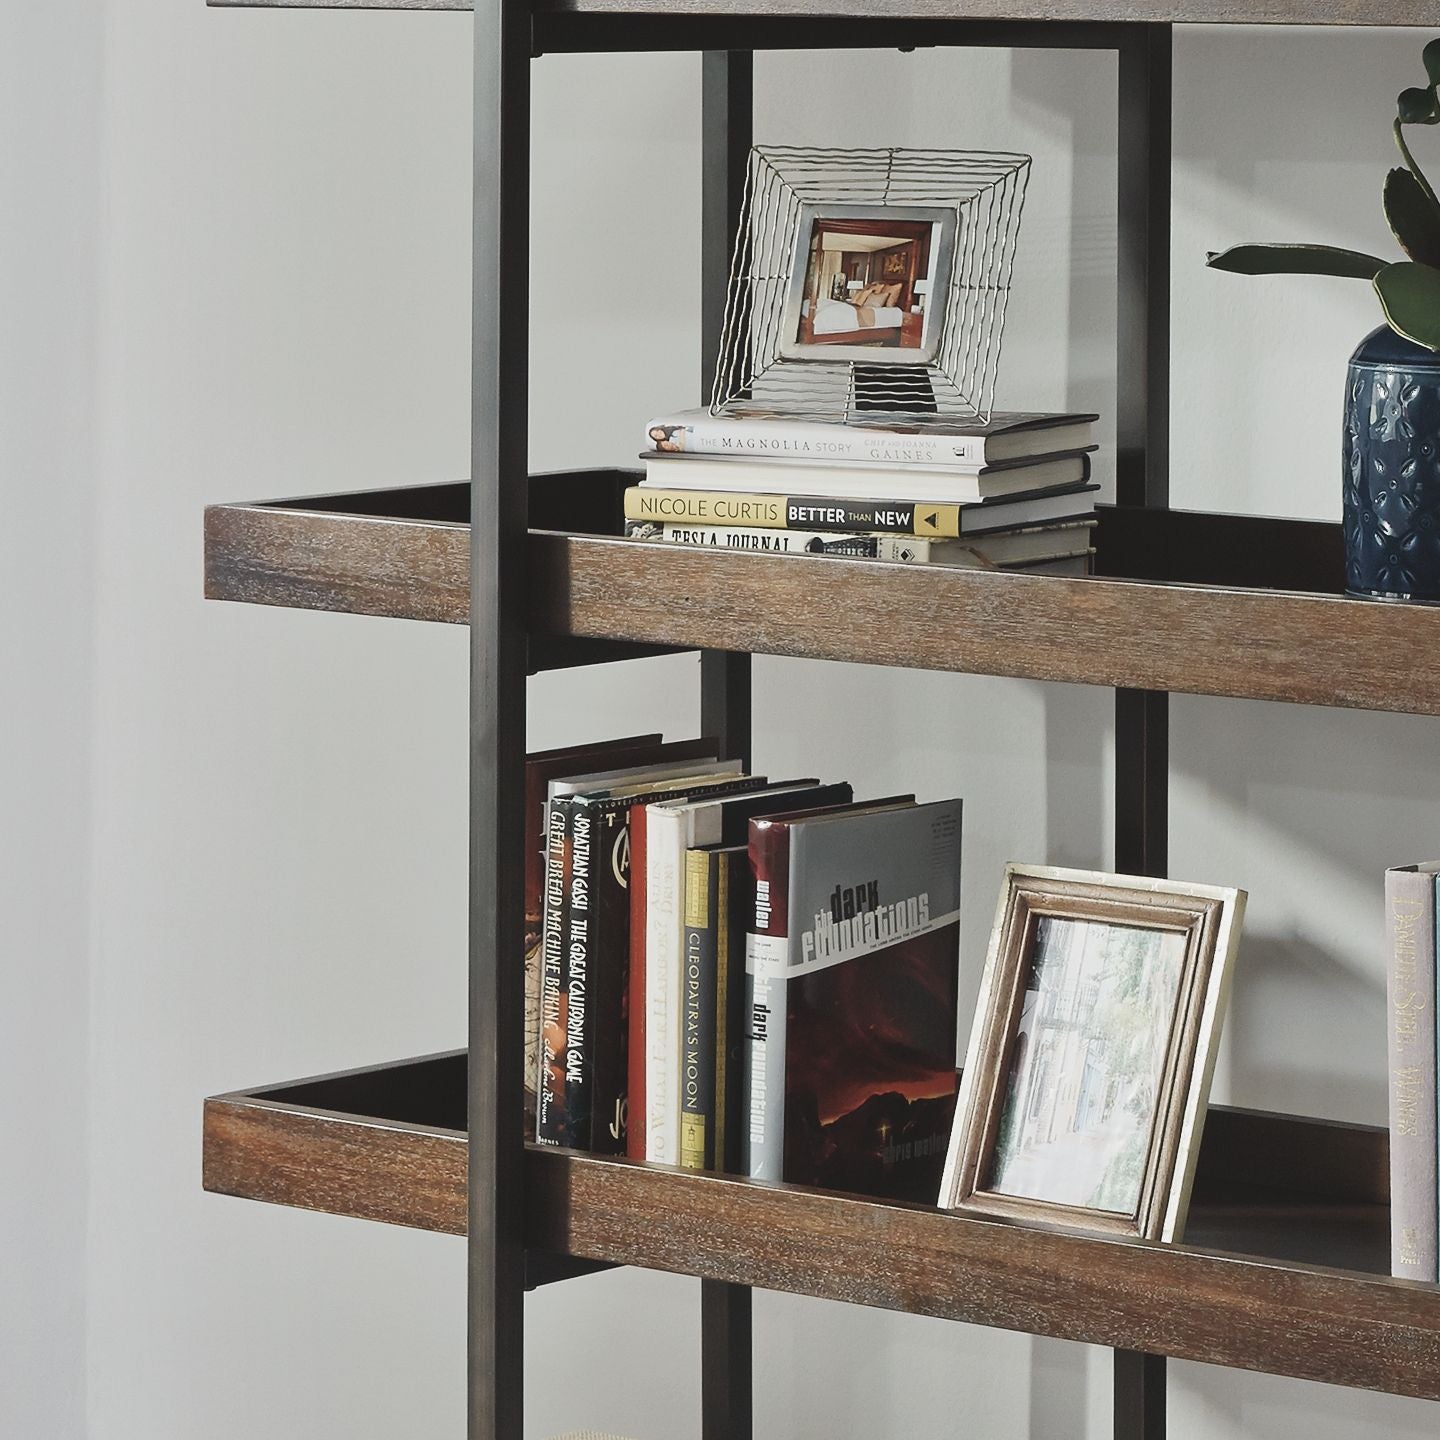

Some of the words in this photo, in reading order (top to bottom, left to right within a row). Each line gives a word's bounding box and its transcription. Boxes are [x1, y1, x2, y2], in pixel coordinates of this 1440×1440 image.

[701, 438, 717, 447] THE
[722, 437, 811, 451] MAGNOLIA
[815, 442, 852, 453] STORY
[870, 449, 934, 461] GAINES
[640, 497, 708, 517] NICOLE
[713, 500, 778, 521] CURTIS
[788, 506, 846, 524] BETTER
[848, 512, 872, 522] THAN
[874, 510, 911, 526] NEW
[549, 810, 566, 857] GREAT
[572, 812, 591, 877] JONATHAN
[548, 859, 565, 907] BREAD
[571, 878, 589, 911] GASH
[829, 879, 880, 924] dark
[545, 908, 563, 975] MACHINE
[570, 919, 588, 942] THE
[801, 892, 929, 964] foundations
[568, 942, 587, 980] GREAT
[543, 976, 561, 1031] BAKING
[687, 932, 701, 1045] CLEOPATRA'S
[566, 980, 586, 1052] CALIFORNIA
[745, 1004, 772, 1042] dark
[566, 1051, 584, 1084] GAME
[686, 1051, 699, 1109] MOON
